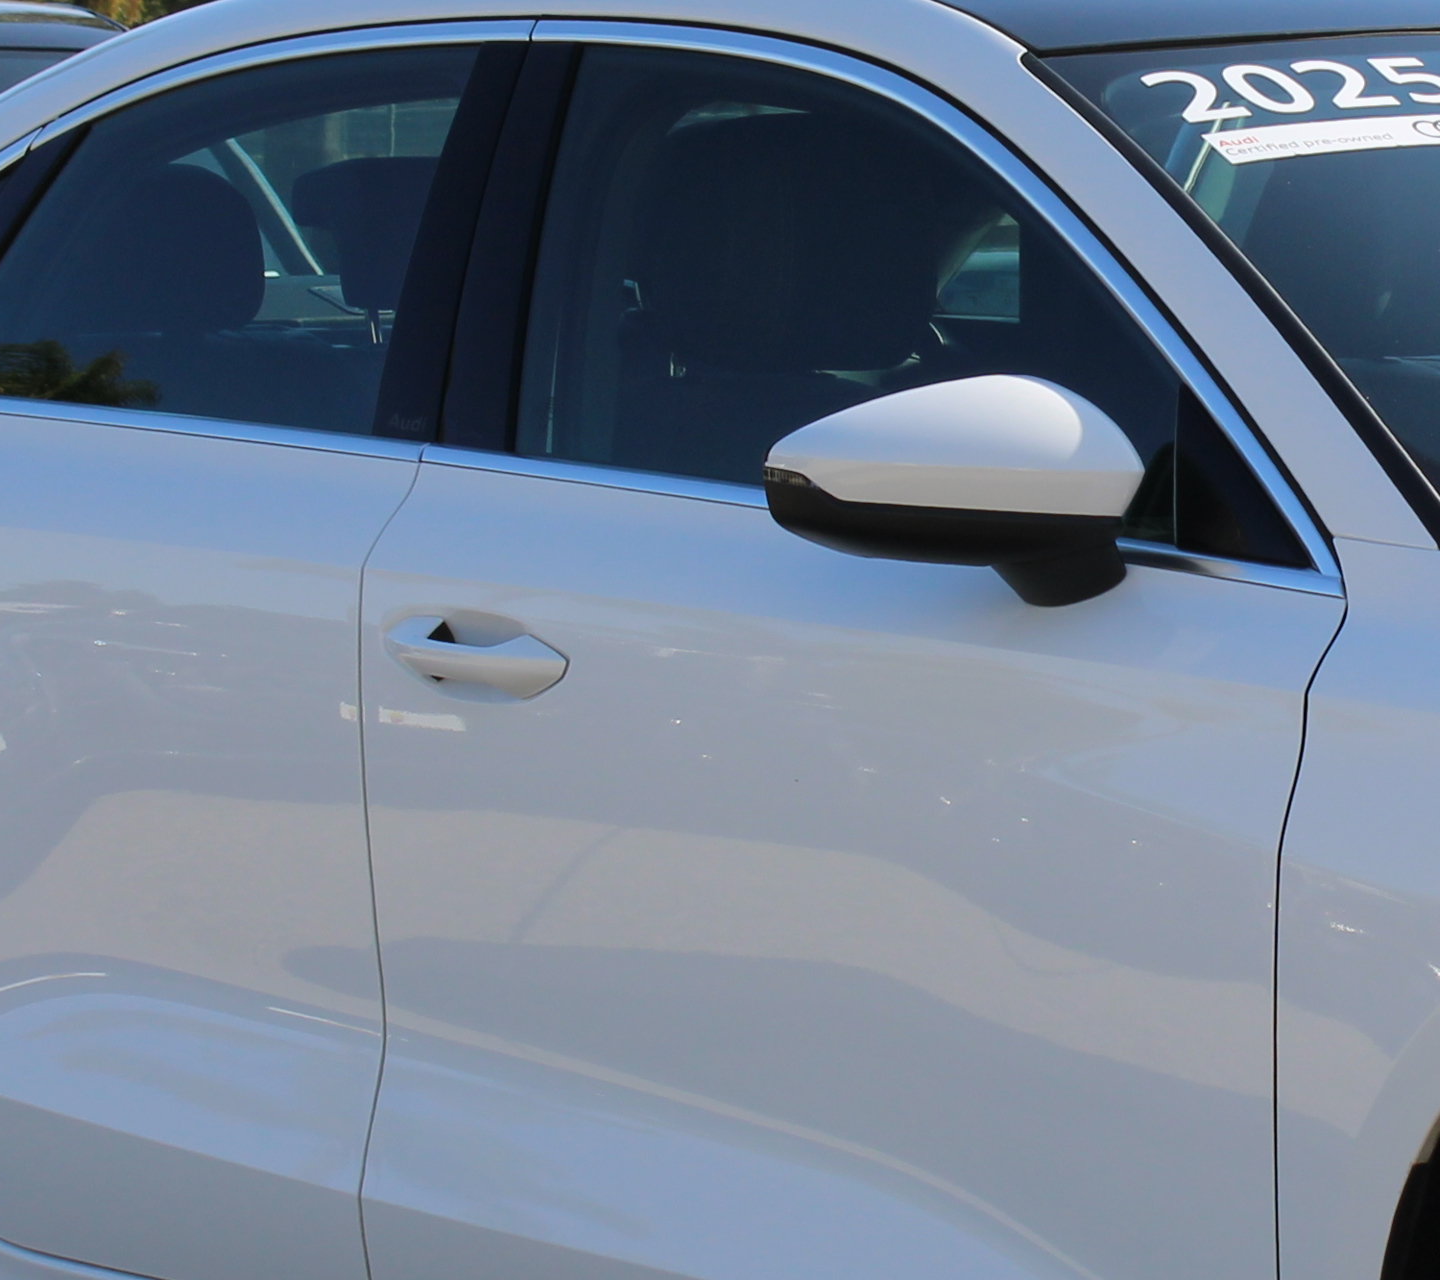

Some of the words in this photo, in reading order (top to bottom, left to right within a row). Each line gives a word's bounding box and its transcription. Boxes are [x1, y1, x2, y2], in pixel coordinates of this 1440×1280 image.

[1218, 136, 1260, 148] Audi
[1225, 140, 1299, 157] Certified
[1303, 131, 1394, 150] pre-owned
